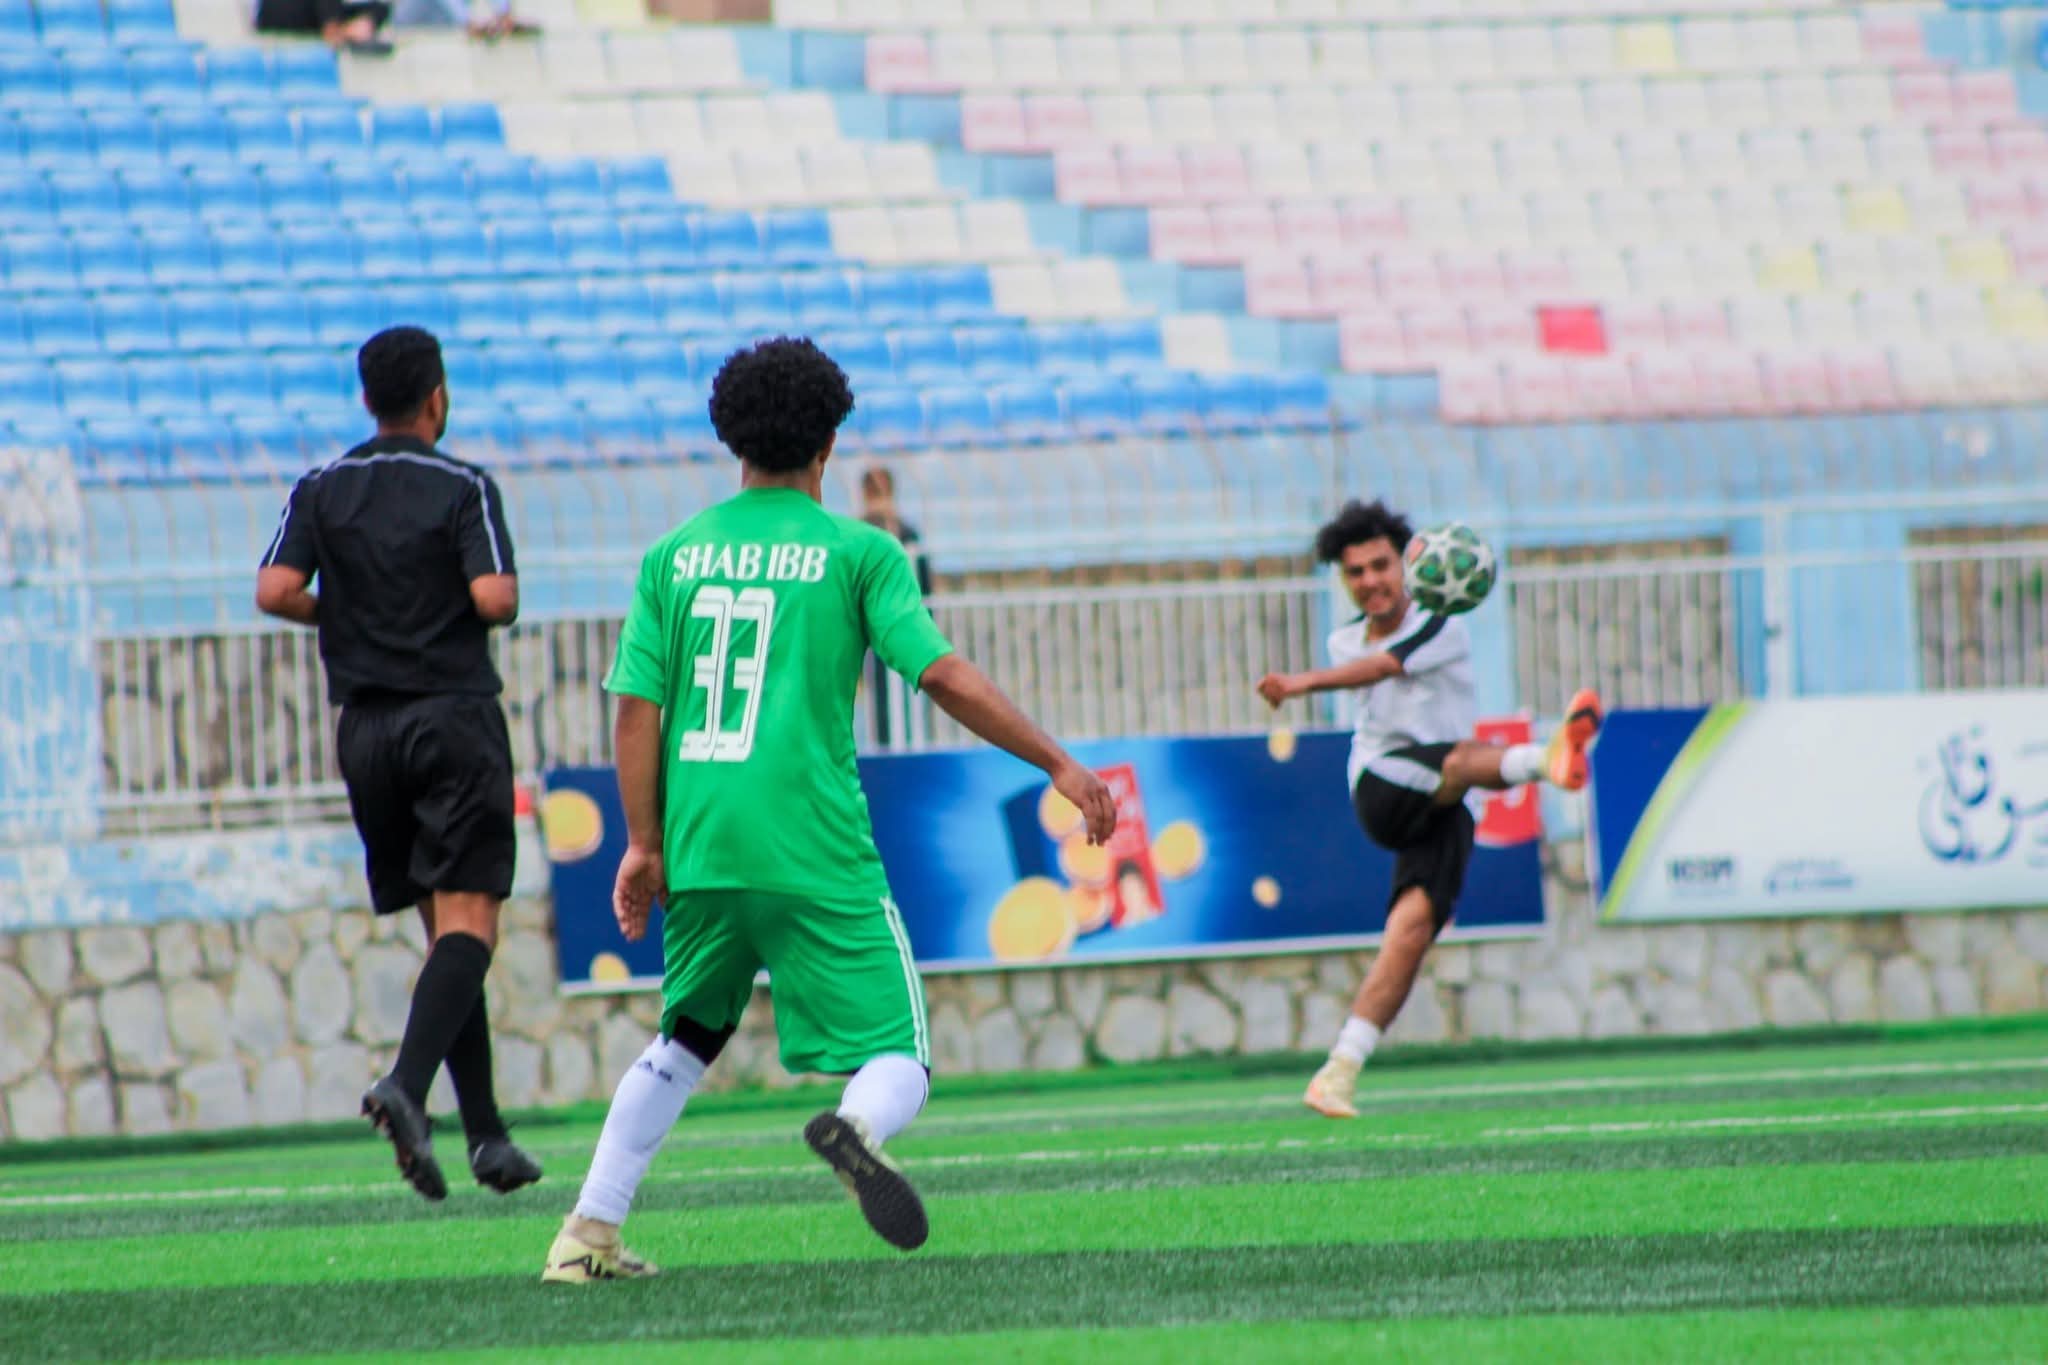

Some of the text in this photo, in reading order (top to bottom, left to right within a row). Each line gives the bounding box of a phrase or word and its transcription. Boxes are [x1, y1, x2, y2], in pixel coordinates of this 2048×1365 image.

[673, 542, 828, 583] SHAB IBB
[679, 585, 776, 762] 33
